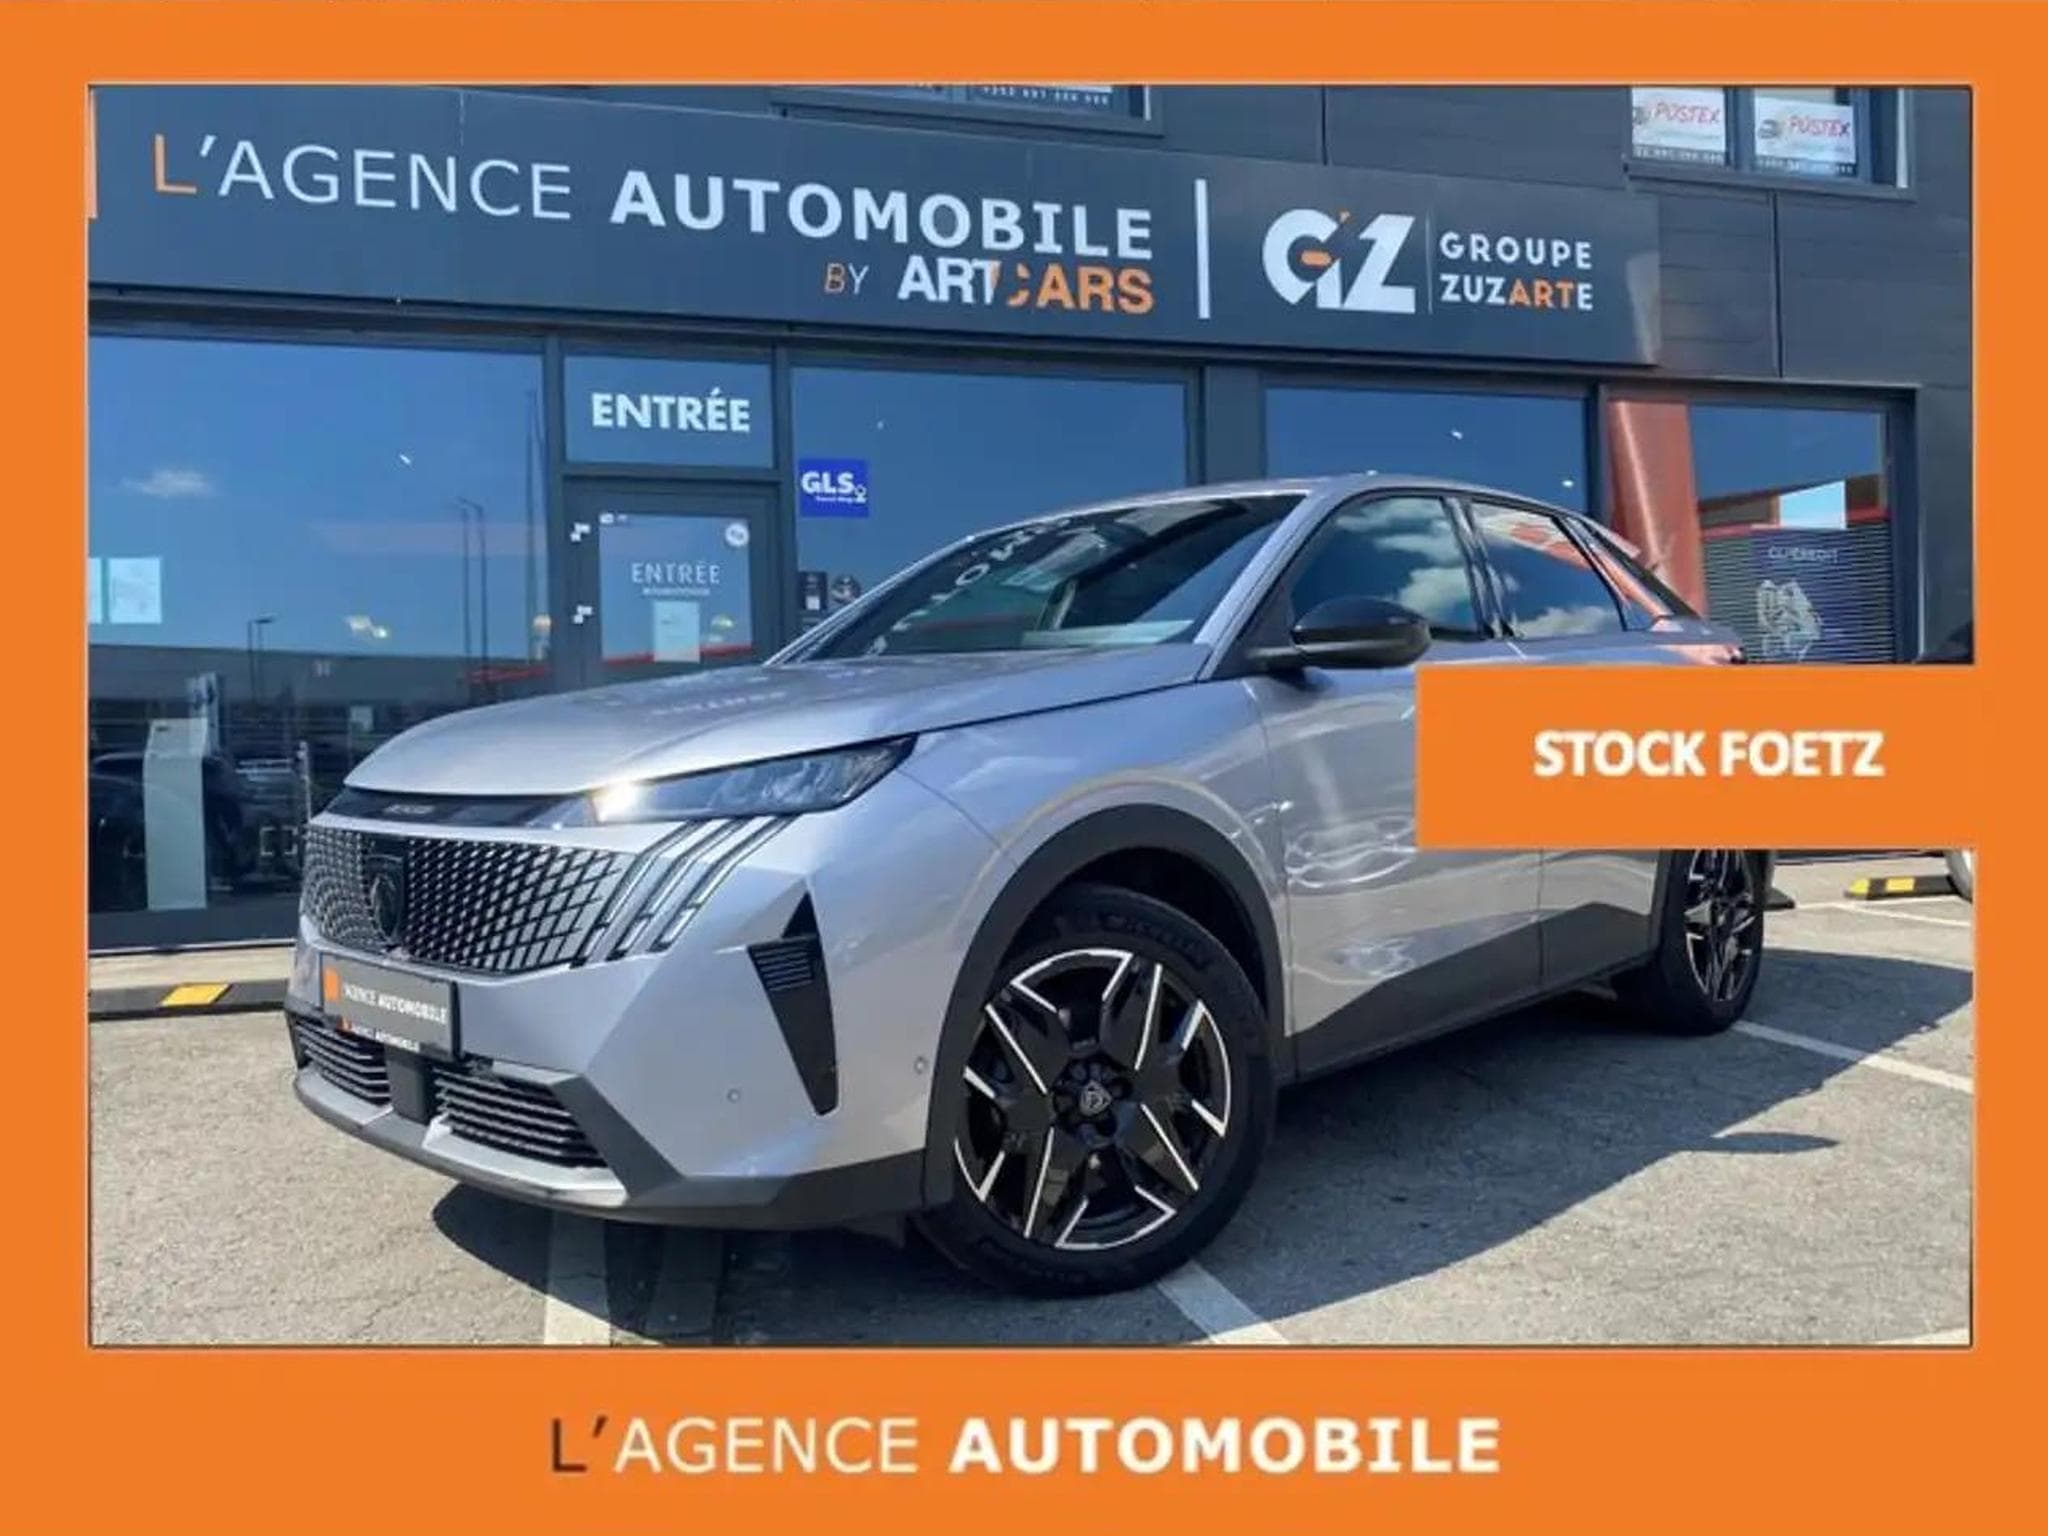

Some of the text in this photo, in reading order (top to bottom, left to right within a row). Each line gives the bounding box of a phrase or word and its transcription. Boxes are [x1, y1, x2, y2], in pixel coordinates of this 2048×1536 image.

[153, 133, 1154, 261] L'AGENCE AUTOMOBILE
[1438, 230, 1592, 271] GROUPE
[823, 262, 868, 295] BY
[1438, 273, 1593, 312] ZUZARTE
[591, 386, 751, 433] ENTRÉE
[801, 470, 855, 495] GLS
